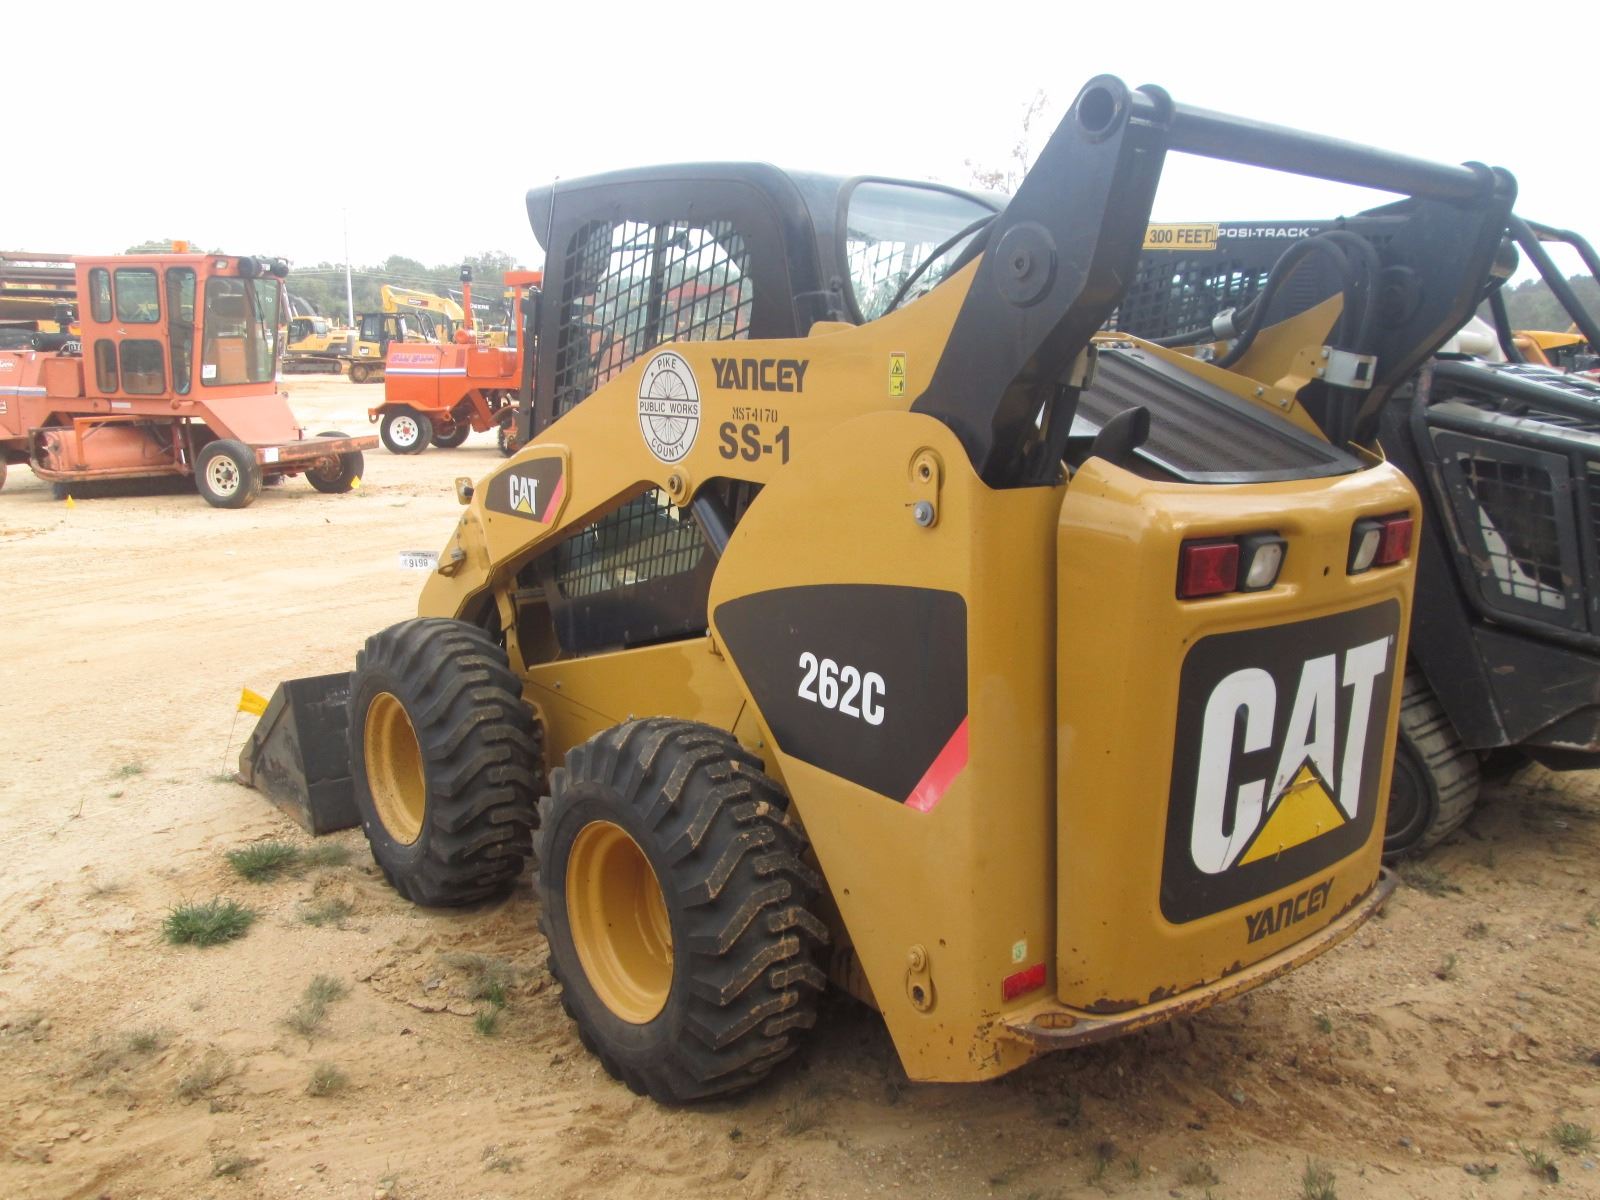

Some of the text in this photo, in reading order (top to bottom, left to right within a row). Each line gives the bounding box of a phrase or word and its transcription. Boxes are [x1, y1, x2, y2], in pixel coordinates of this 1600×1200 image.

[1150, 228, 1211, 244] 300 FEET
[657, 357, 677, 371] PIKE
[711, 357, 810, 393] YANCEY
[640, 401, 699, 415] PUBLIC WORKS
[651, 437, 686, 458] COUNTY
[718, 421, 790, 465] SS-1
[509, 474, 538, 515] CAT
[798, 651, 886, 726] 262C
[1190, 634, 1390, 874] CAT
[1245, 875, 1335, 945] YANCEY
